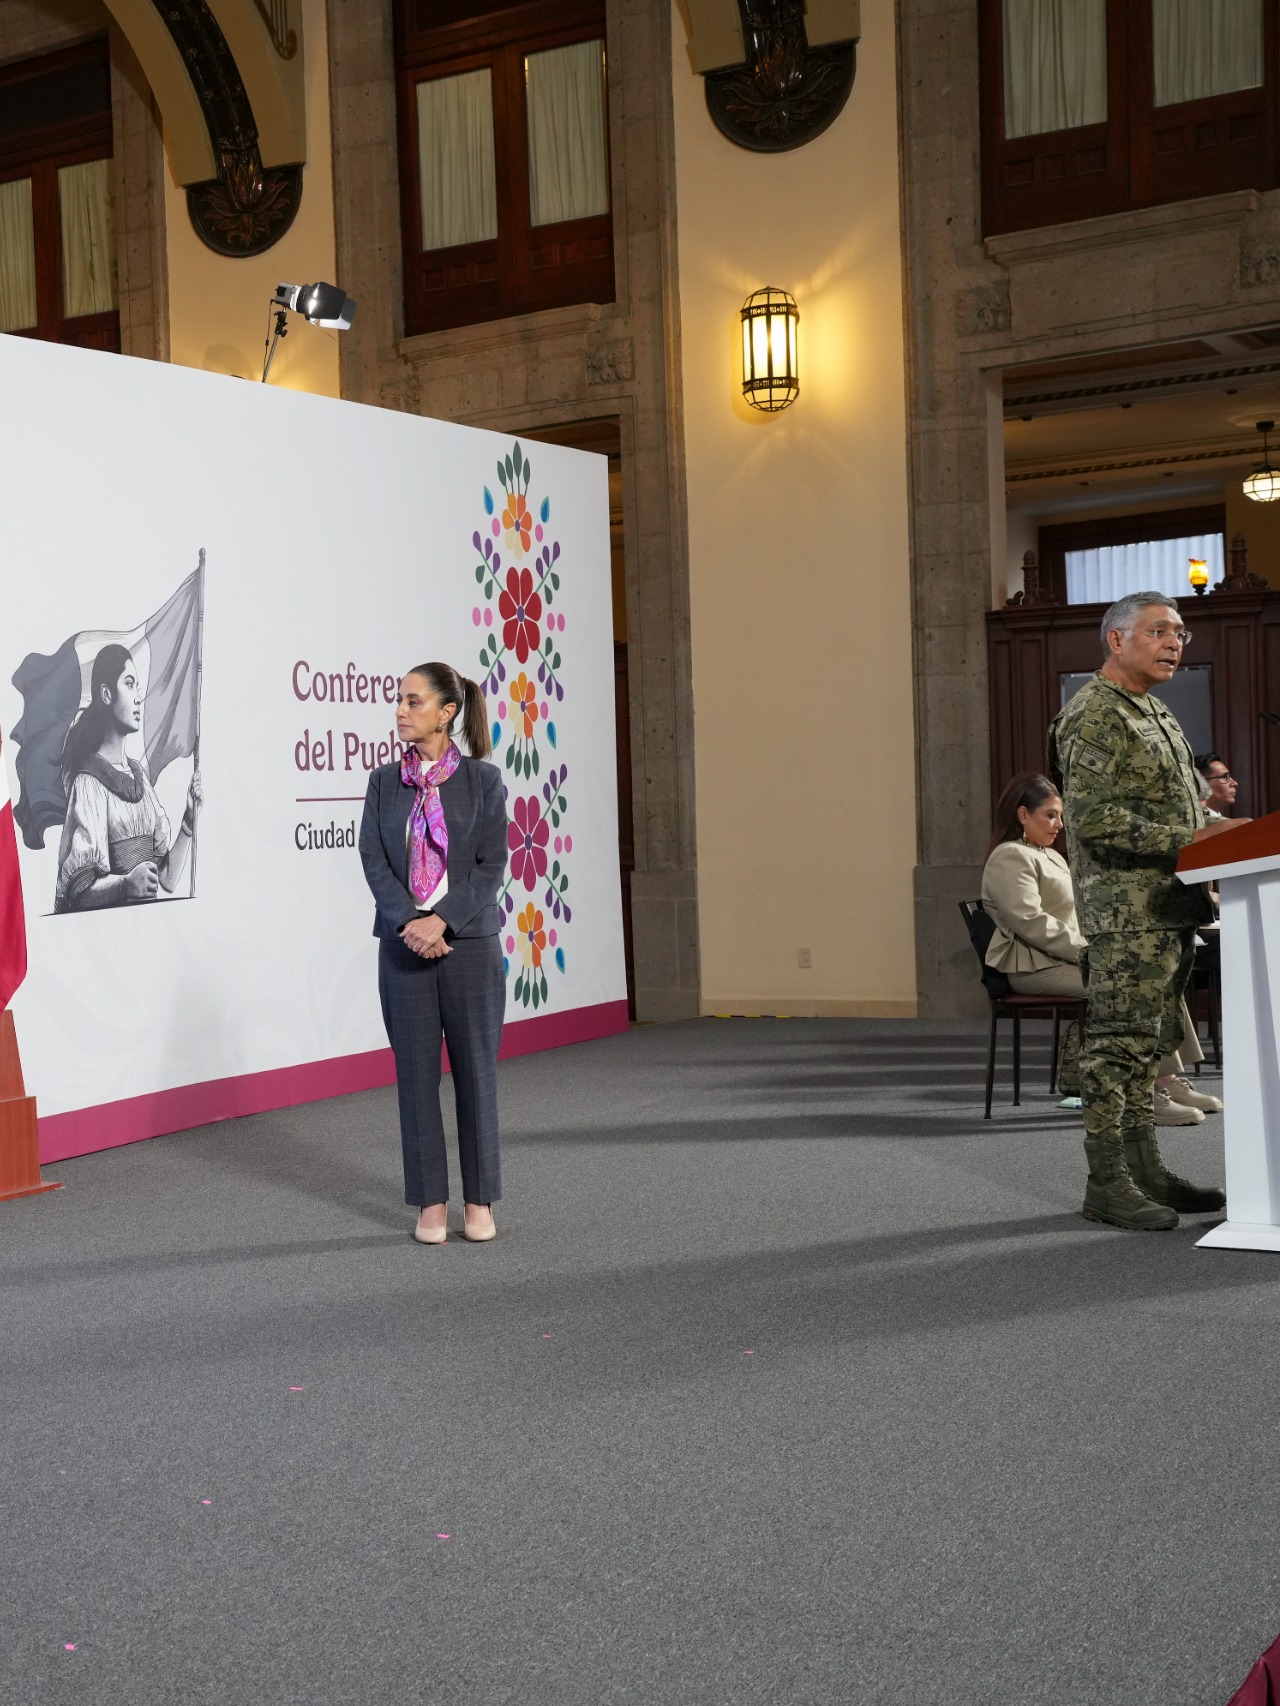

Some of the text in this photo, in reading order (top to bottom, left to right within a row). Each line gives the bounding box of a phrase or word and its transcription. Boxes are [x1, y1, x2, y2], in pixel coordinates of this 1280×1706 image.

[294, 728, 410, 771] del Pueb
[294, 819, 356, 851] Ciudad
